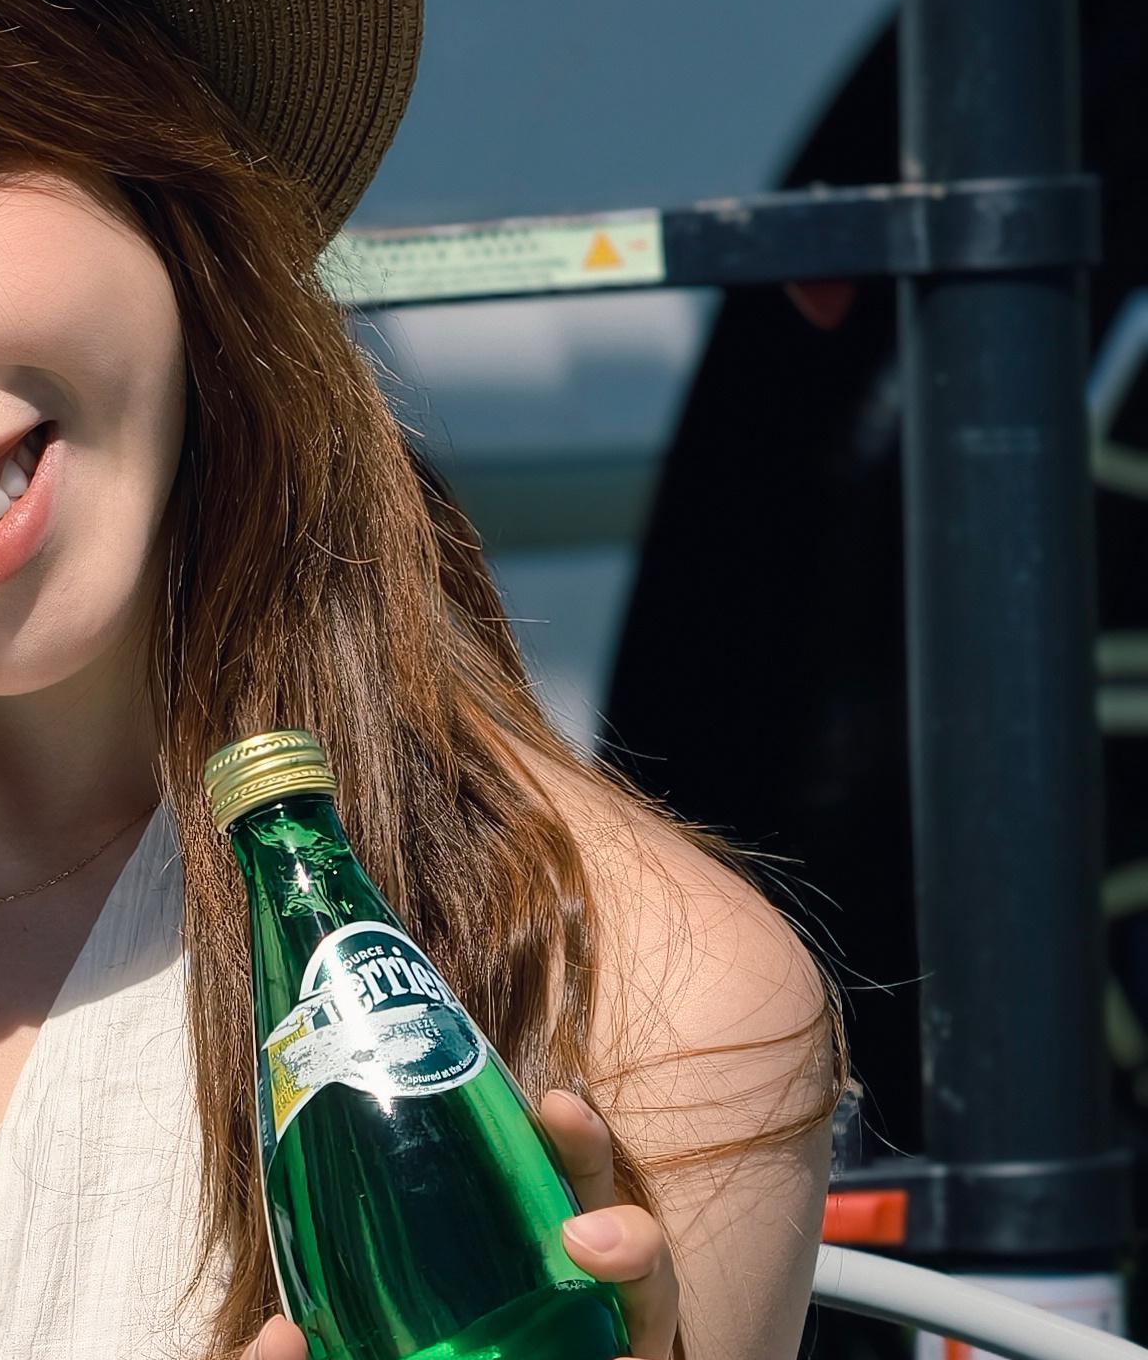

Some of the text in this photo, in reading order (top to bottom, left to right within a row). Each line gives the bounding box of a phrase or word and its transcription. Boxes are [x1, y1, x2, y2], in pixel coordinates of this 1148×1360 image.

[340, 945, 385, 971] OURCE
[400, 1070, 441, 1085] Captured
[440, 1069, 450, 1078] at
[449, 1062, 463, 1073] the
